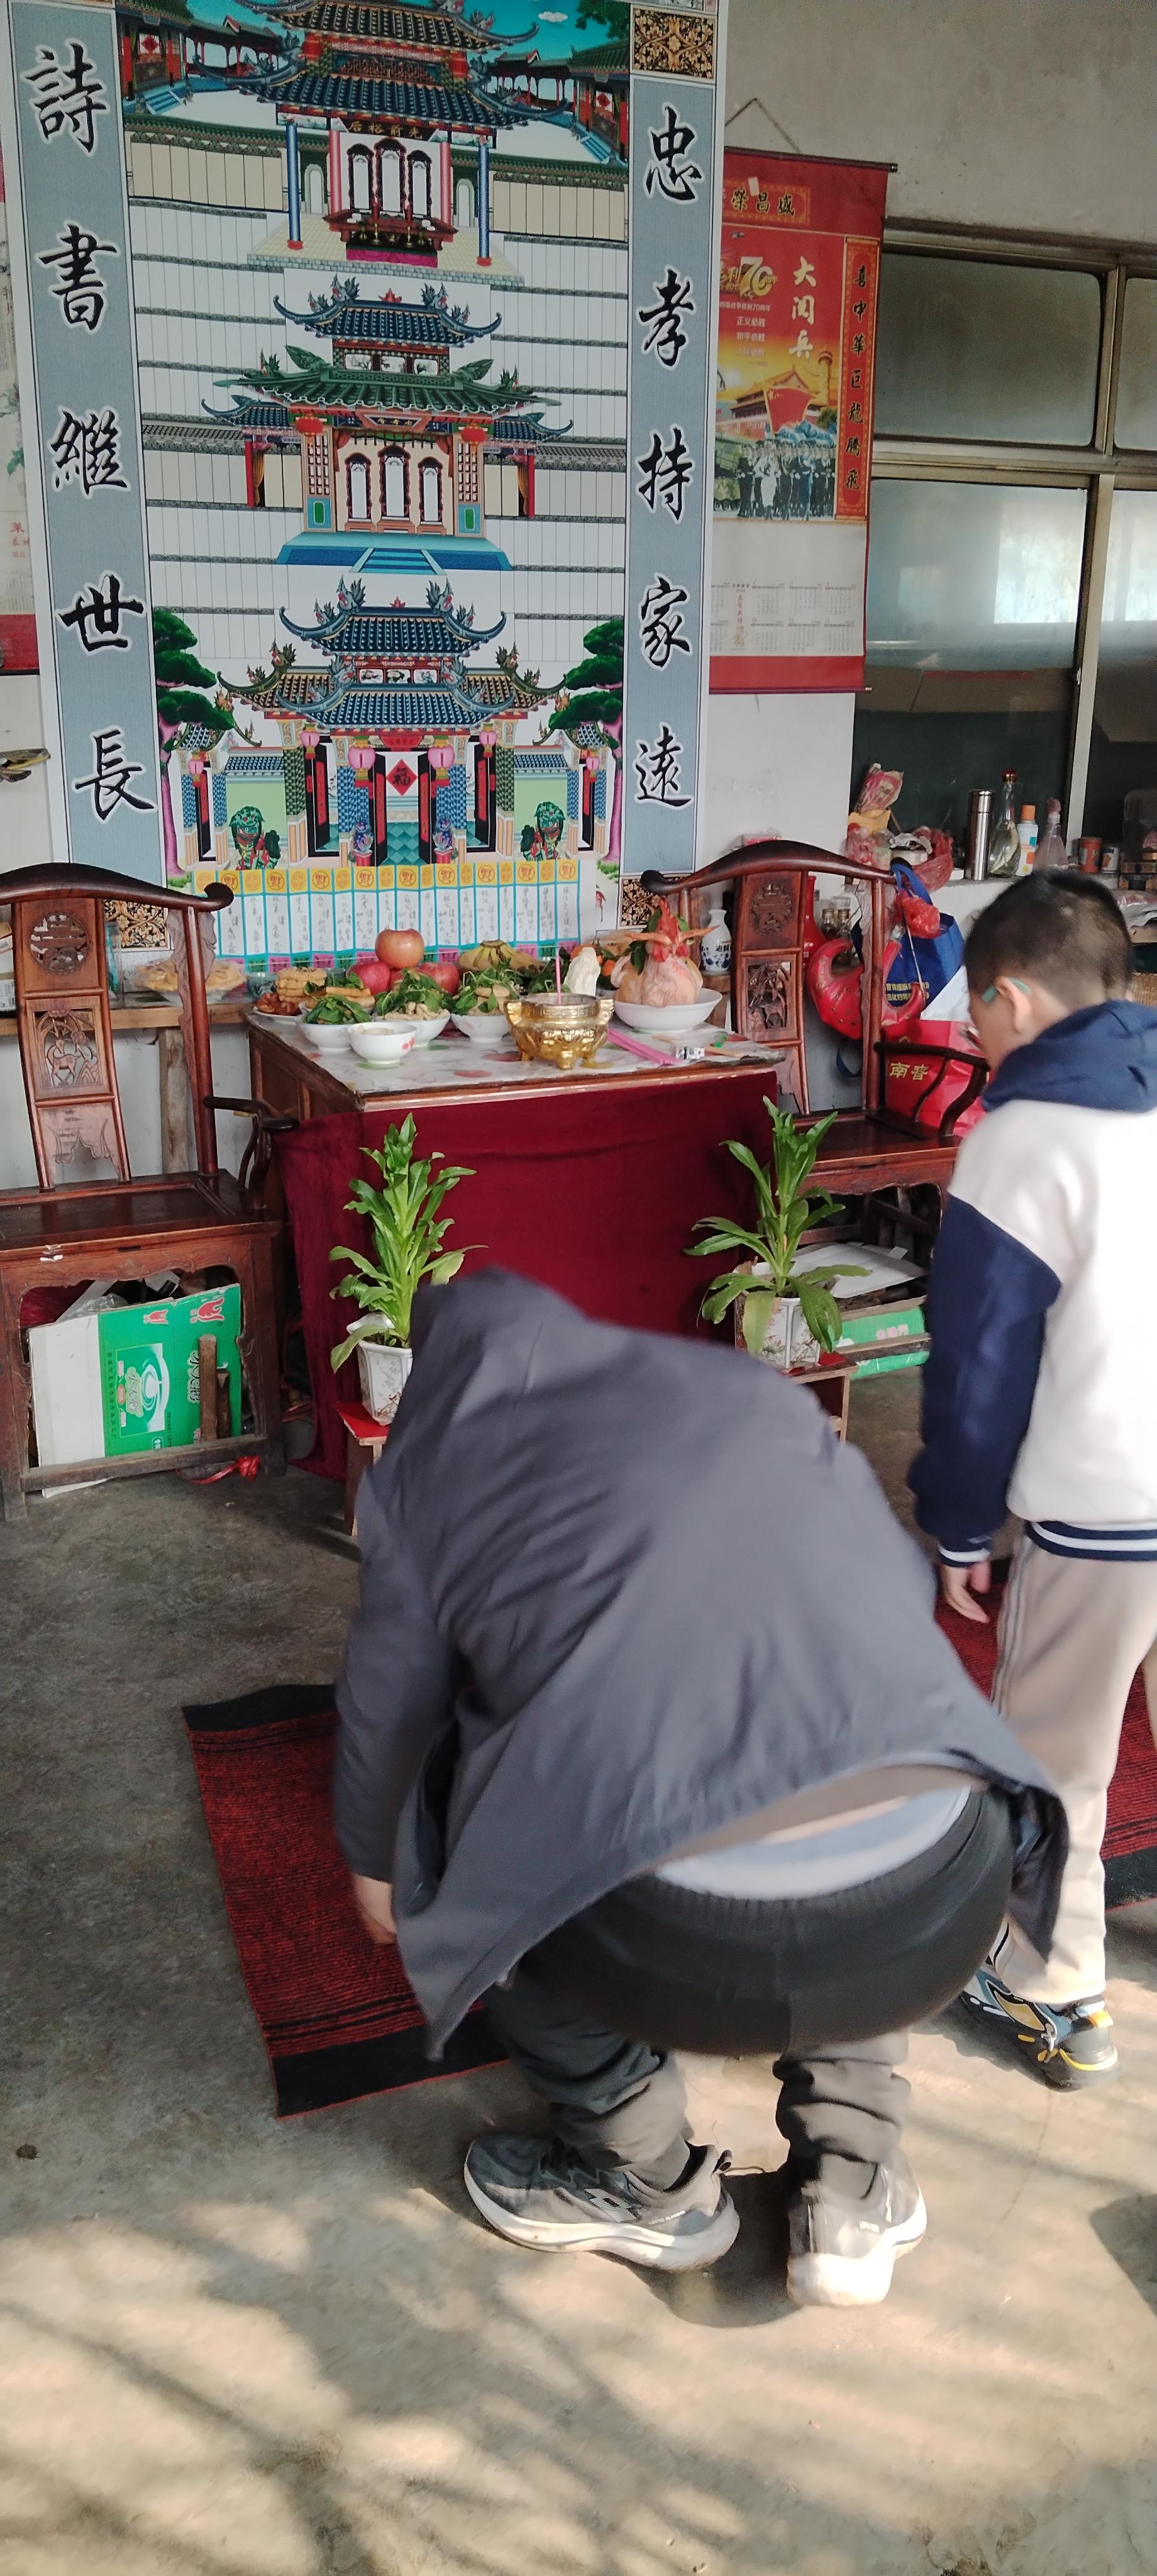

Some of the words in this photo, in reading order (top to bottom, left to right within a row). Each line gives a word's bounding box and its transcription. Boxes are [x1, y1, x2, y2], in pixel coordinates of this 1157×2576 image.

[723, 187, 795, 216] 榮昌盛
[737, 316, 766, 327] 正义必胜
[27, 42, 155, 819] 詩書繼世長
[638, 106, 702, 806] 忠孝持家遠
[886, 1061, 929, 1080] 南春
